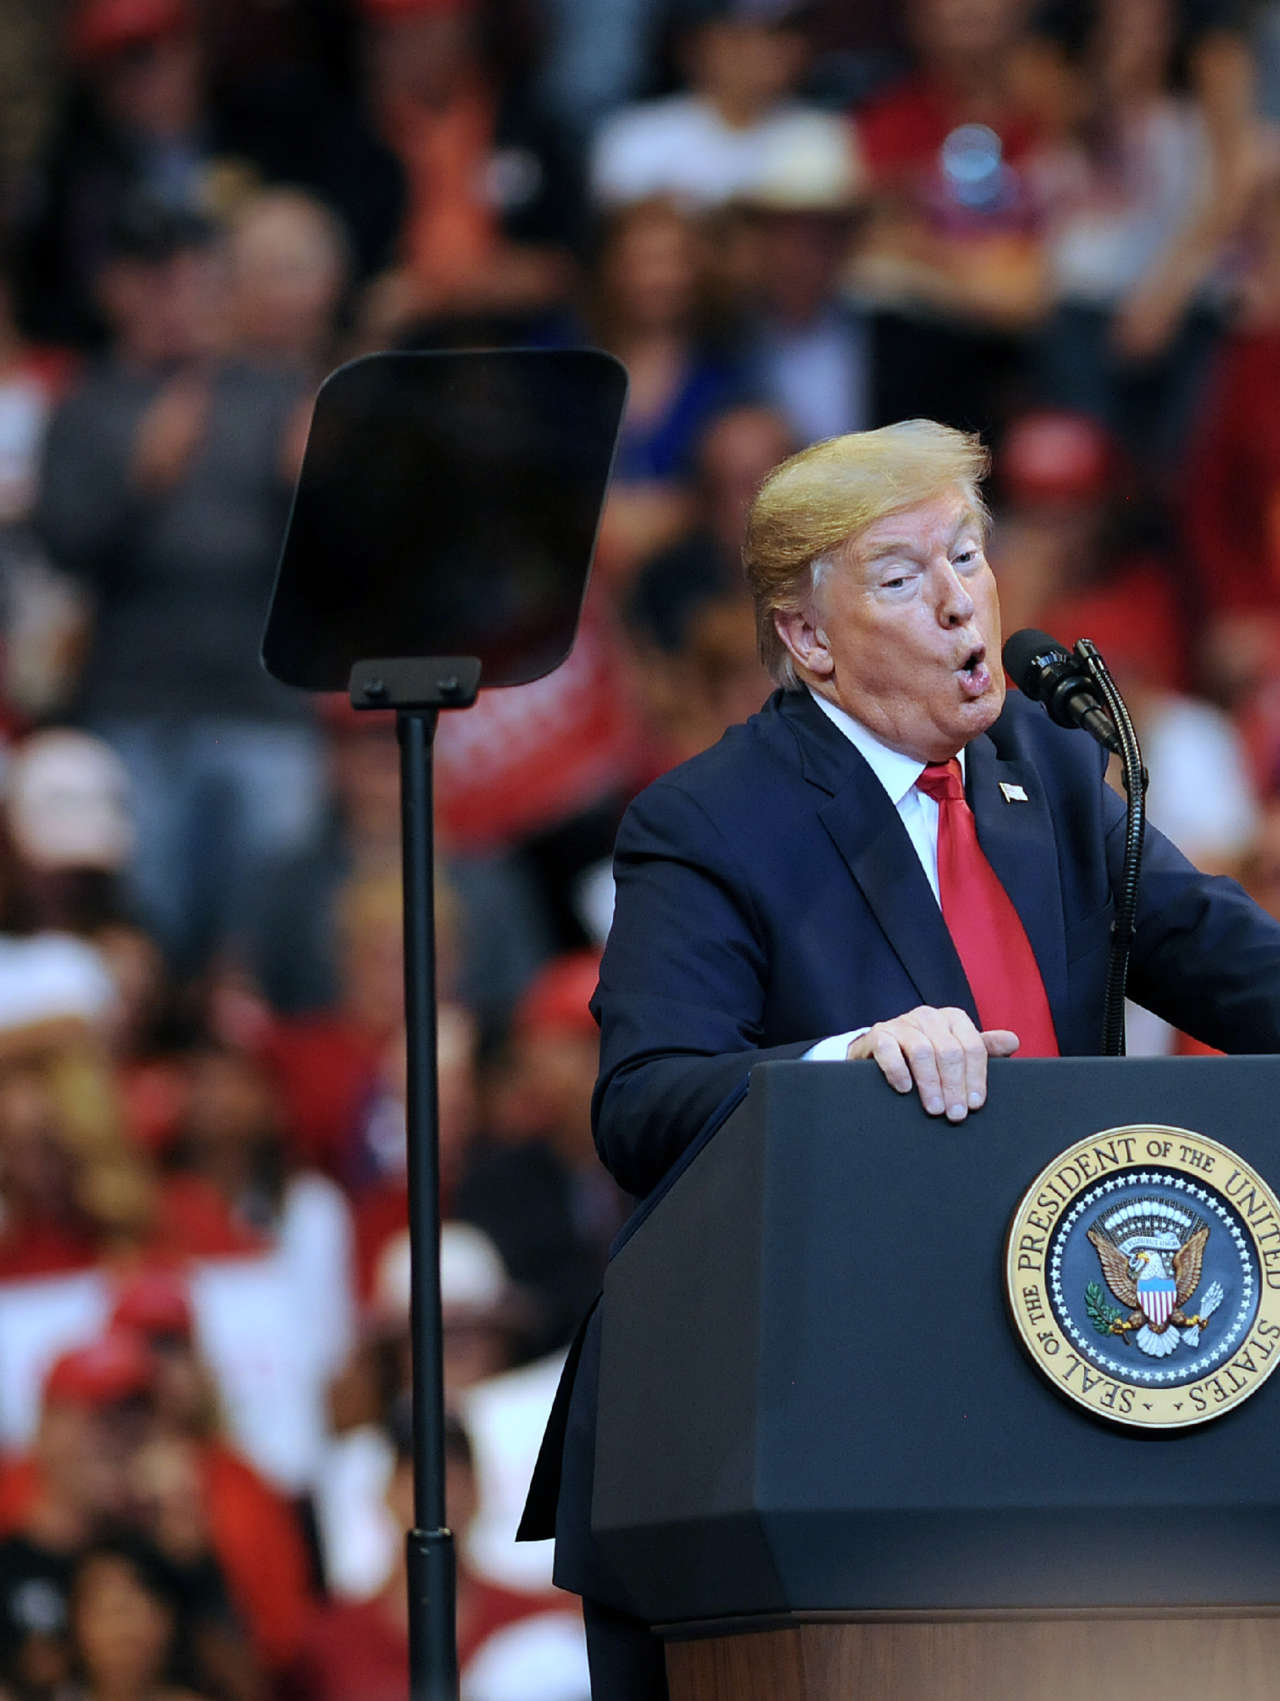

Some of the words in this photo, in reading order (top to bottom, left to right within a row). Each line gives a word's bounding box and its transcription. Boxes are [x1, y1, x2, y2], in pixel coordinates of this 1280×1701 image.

[1146, 1140, 1172, 1157] OF
[1180, 1144, 1216, 1173] THE
[1018, 1138, 1136, 1272] PRESIDENT
[1023, 1284, 1045, 1325] THE
[1036, 1330, 1060, 1355] OF
[1062, 1354, 1136, 1413] SEAL
[1189, 1318, 1280, 1411] STATES
